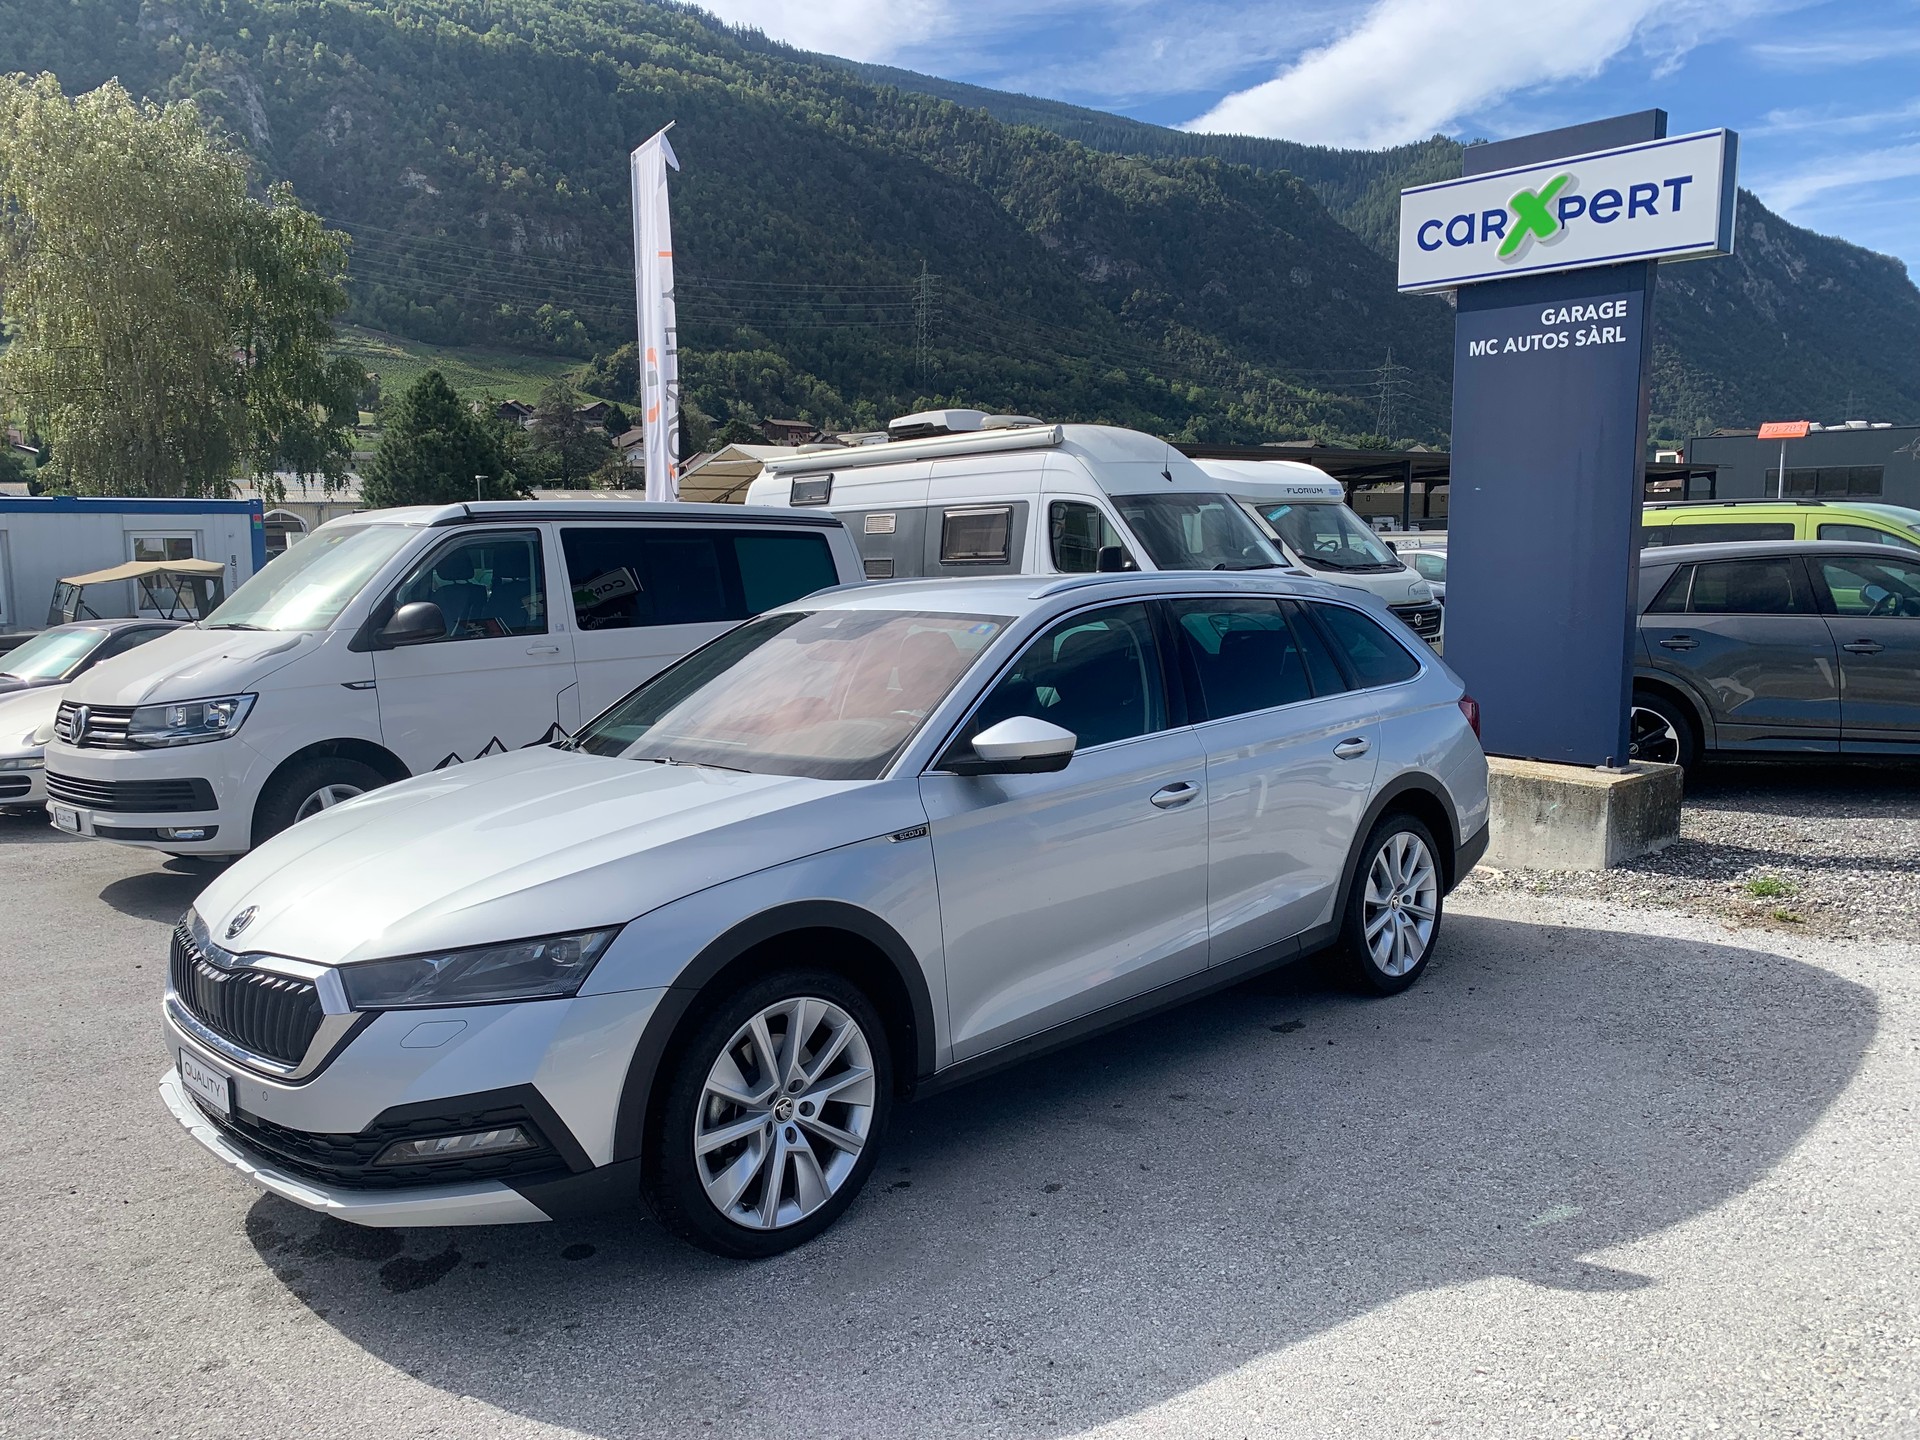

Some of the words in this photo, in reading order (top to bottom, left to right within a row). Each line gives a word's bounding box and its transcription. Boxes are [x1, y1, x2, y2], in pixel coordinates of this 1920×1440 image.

[1541, 300, 1627, 326] GARAGE
[1469, 340, 1498, 357] MC
[1503, 332, 1569, 354] AUTOS
[1575, 325, 1626, 346] SÀRL
[899, 829, 924, 840] SCOUT
